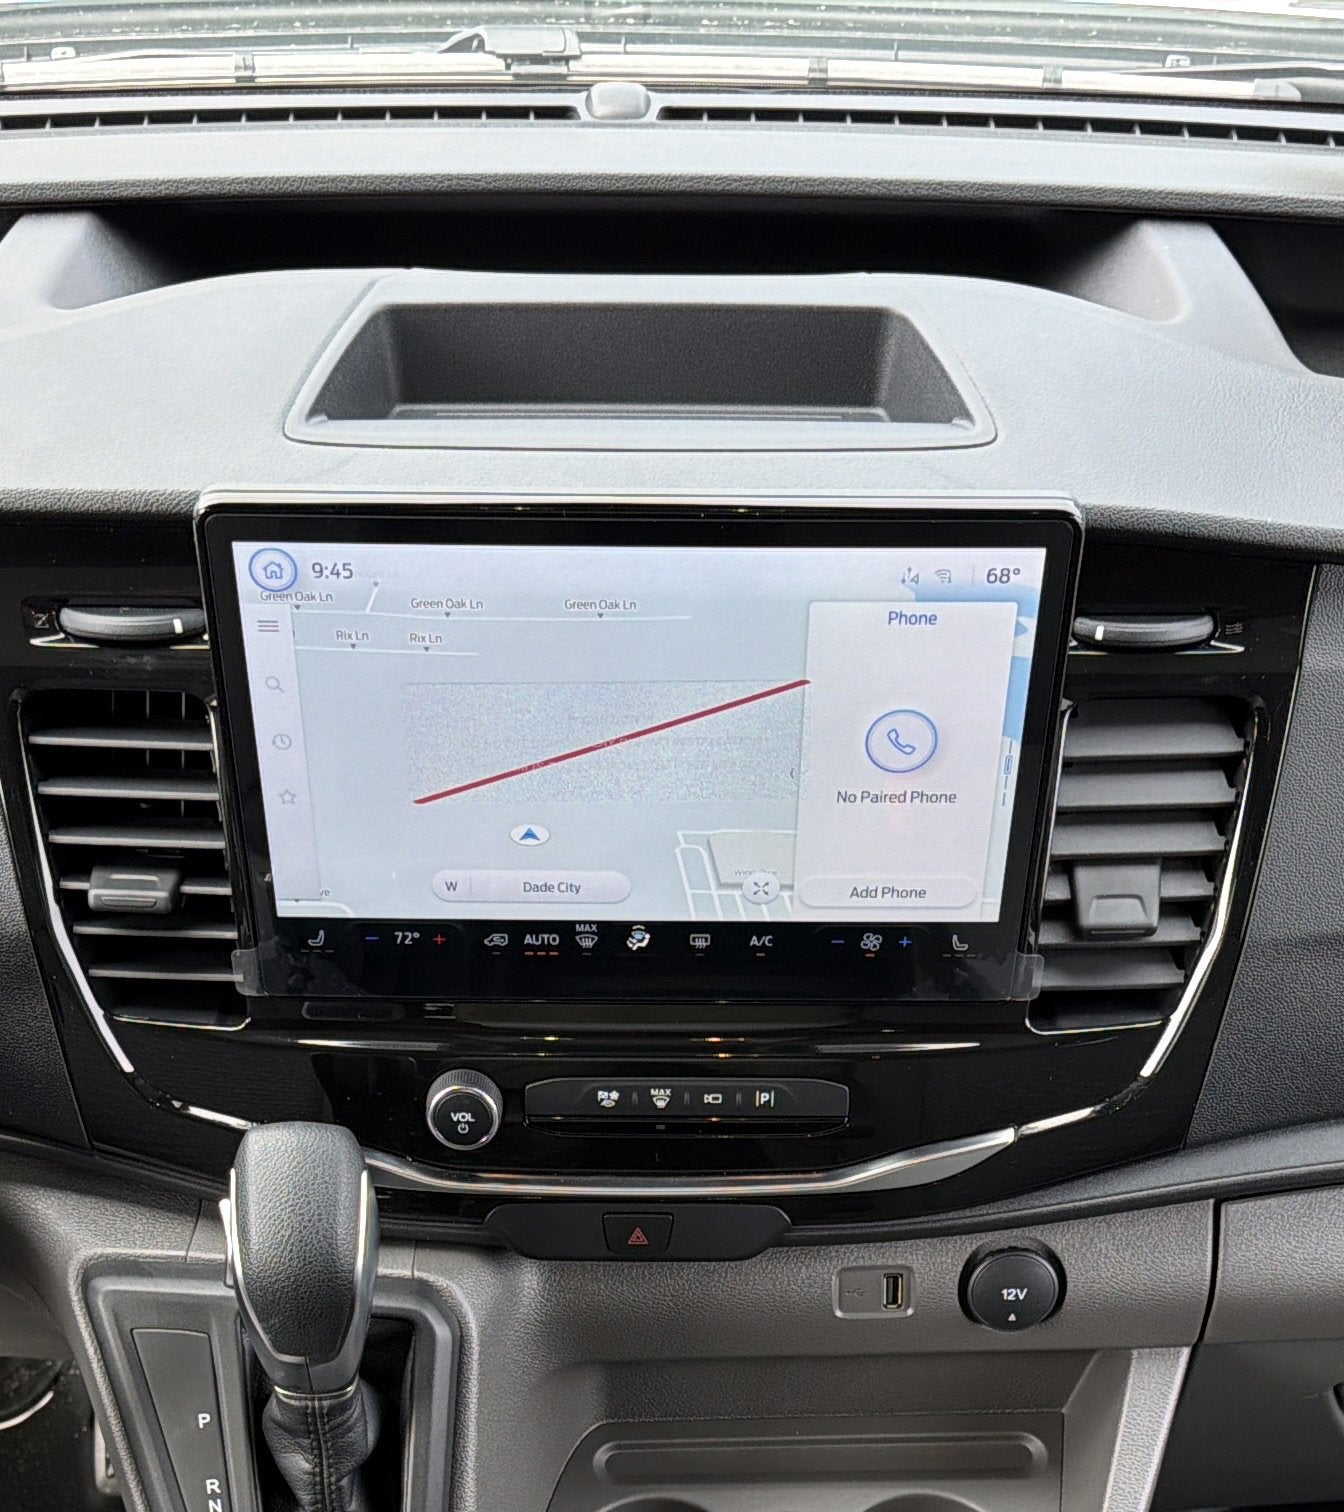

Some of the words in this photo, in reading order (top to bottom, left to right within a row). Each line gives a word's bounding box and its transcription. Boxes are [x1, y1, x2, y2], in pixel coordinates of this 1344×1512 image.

[311, 562, 354, 580] 9:45
[986, 567, 1021, 584] 68°
[260, 591, 293, 602] Green
[294, 592, 317, 602] Oak
[318, 592, 333, 602] Ln
[410, 599, 443, 610] Green
[444, 599, 467, 610] Oak
[469, 600, 484, 610] Ln
[564, 599, 597, 610] Green
[598, 599, 620, 610] Oak
[621, 600, 637, 610] Ln
[887, 610, 938, 626] Phone
[335, 630, 353, 641] Rix
[354, 631, 369, 642] Ln
[409, 633, 426, 644] Rix
[428, 633, 443, 644] Ln
[836, 791, 858, 804] No
[860, 790, 907, 804] Paired
[910, 791, 957, 805] Phone
[444, 881, 458, 892] W
[523, 881, 554, 893] Dade
[556, 881, 582, 895] City
[849, 886, 879, 899] Add
[881, 887, 927, 899] Phone
[575, 923, 598, 933] MAX
[394, 931, 421, 945] 72°
[523, 933, 560, 946] AUTO
[749, 935, 774, 948] A/C
[649, 1088, 671, 1097] MAX
[450, 1112, 476, 1122] VOL
[1000, 1288, 1028, 1301] 12V
[198, 1413, 211, 1429] P
[205, 1478, 221, 1494] R
